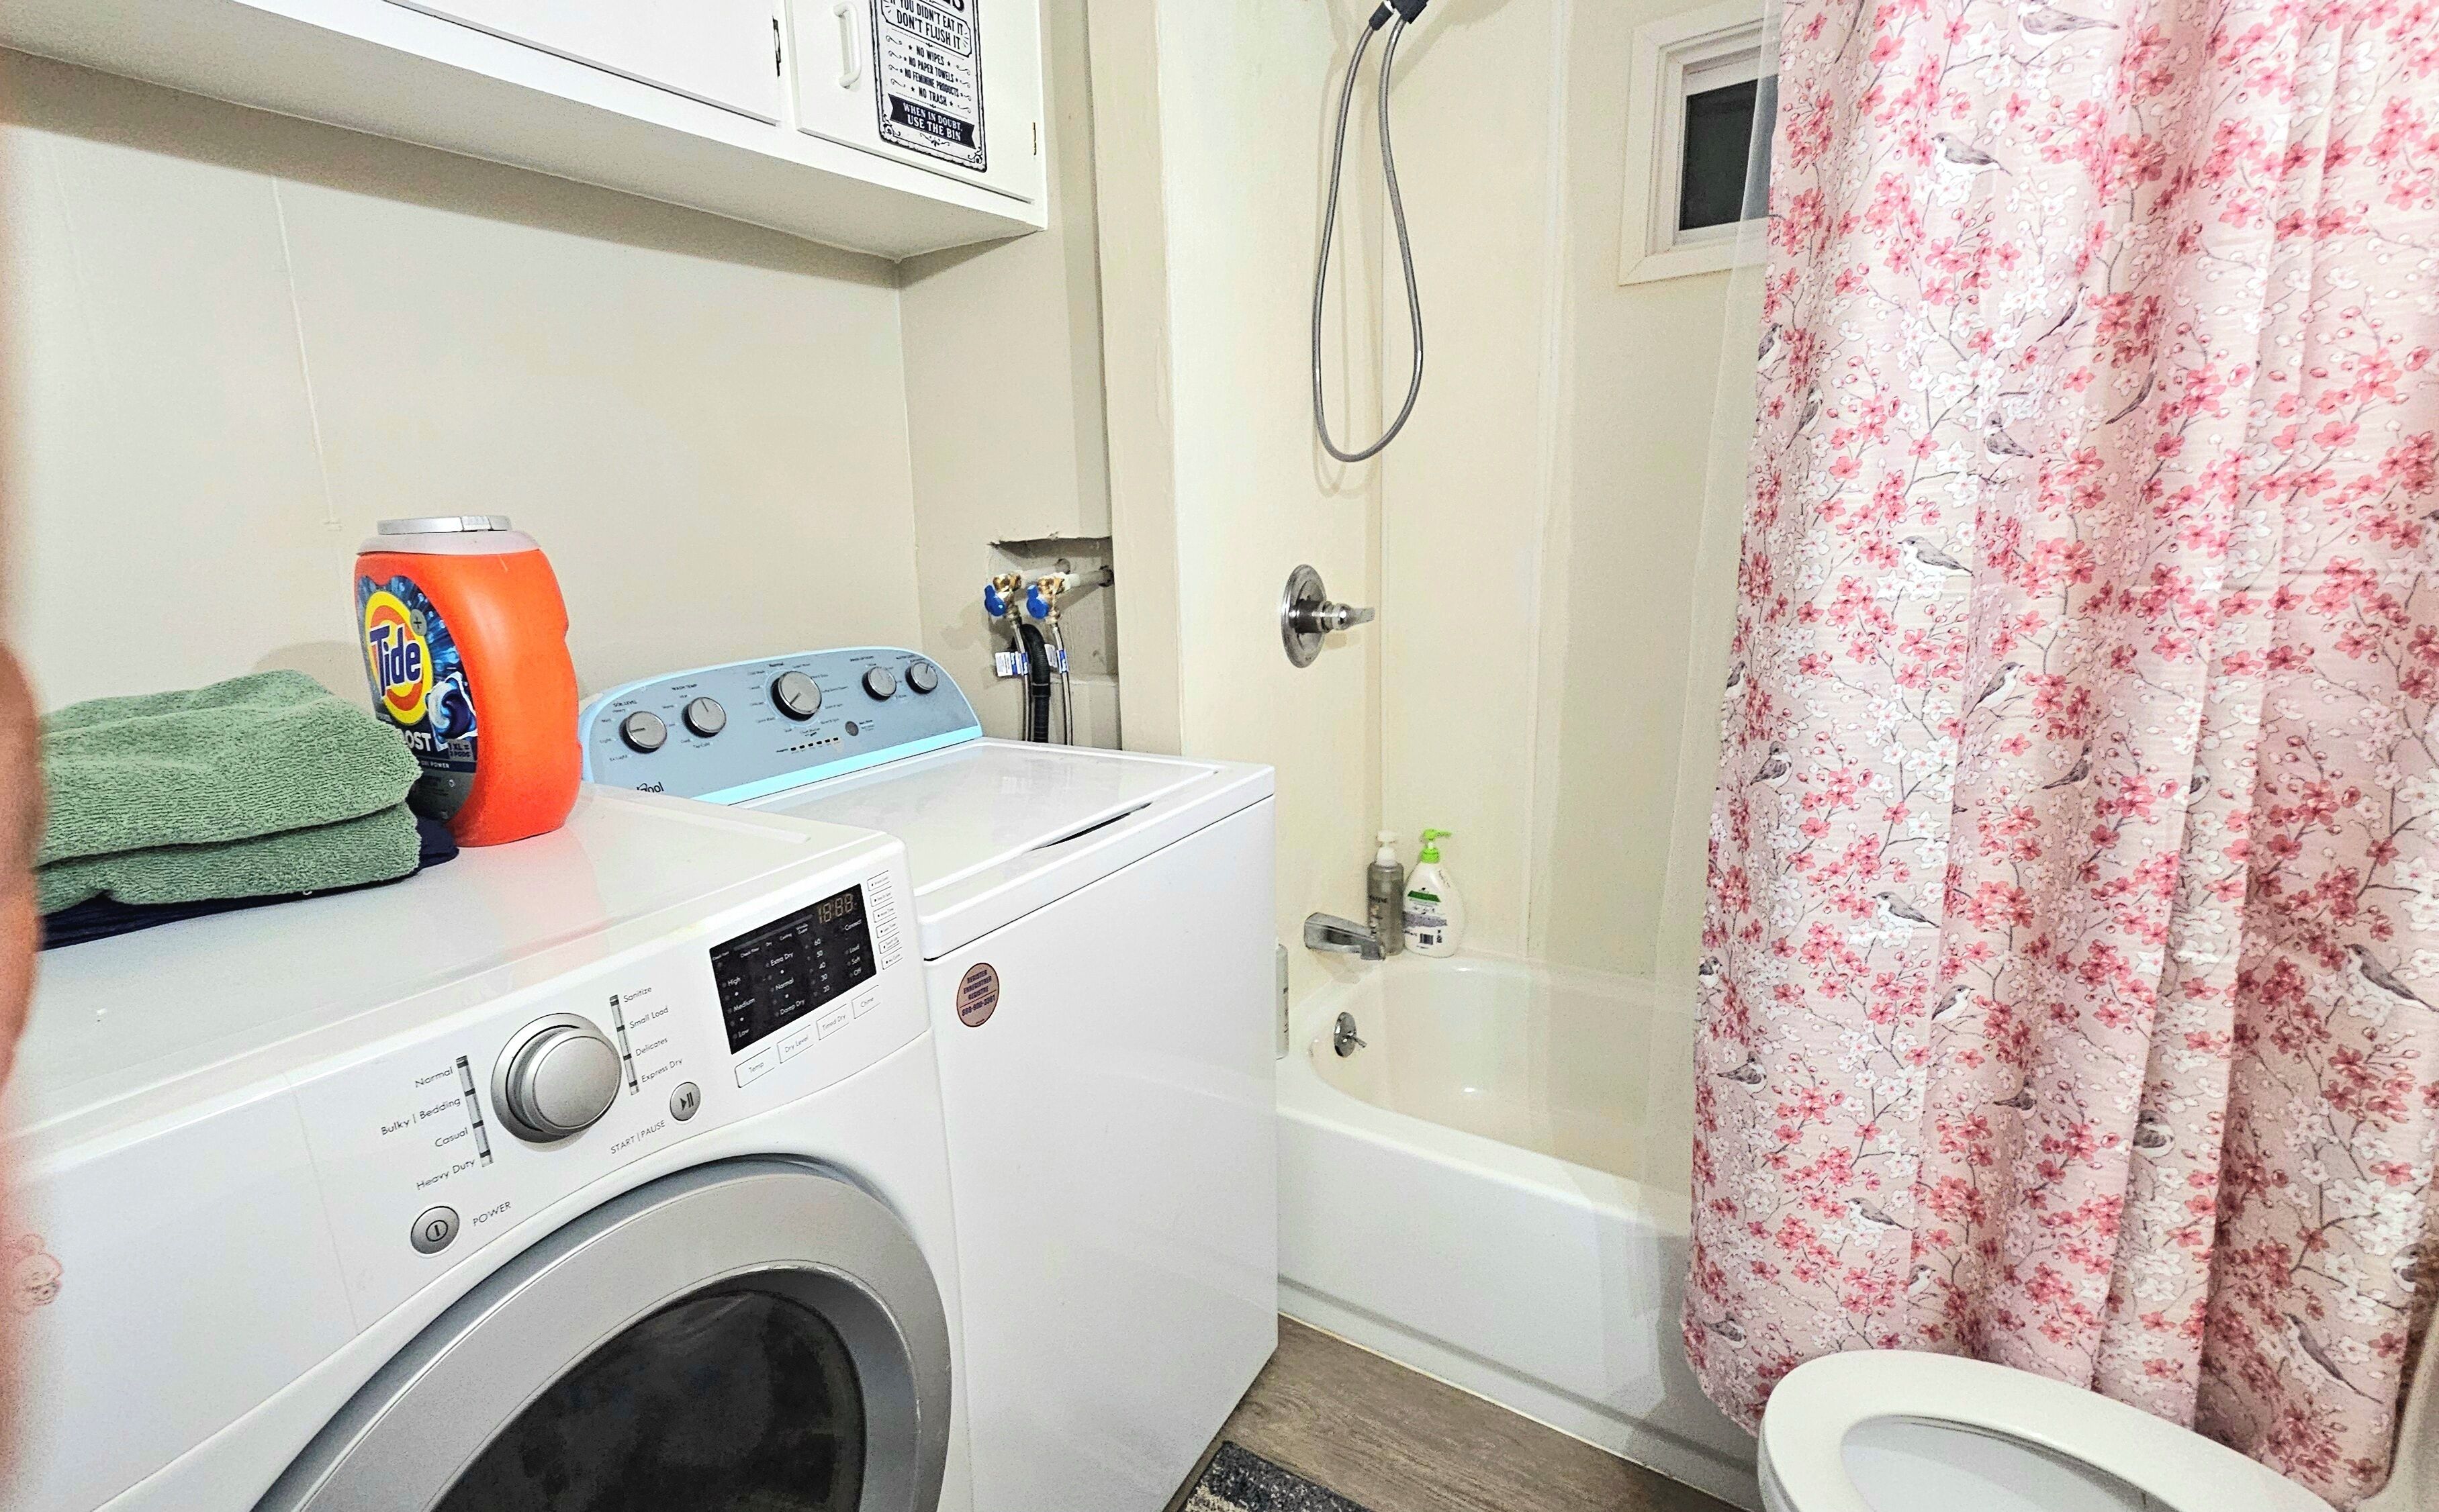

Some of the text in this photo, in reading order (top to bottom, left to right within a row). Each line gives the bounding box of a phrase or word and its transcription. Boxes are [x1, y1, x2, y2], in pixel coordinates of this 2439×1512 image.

[917, 3, 940, 24] DIDN'T
[944, 15, 955, 32] EAT
[957, 21, 963, 35] IT
[896, 9, 960, 50] DON'T FLUSH IT
[917, 46, 944, 66] NO WIPES
[905, 68, 911, 79] NO
[909, 56, 954, 83] NO PAPER TOWELS
[919, 87, 947, 106] NO TRASH
[903, 102, 926, 117] WHEN
[928, 111, 935, 122] IN
[907, 114, 961, 141] USE THE BIN
[370, 625, 421, 696] Tide
[405, 730, 431, 751] OST
[814, 938, 821, 946] 60
[849, 943, 860, 953] Loud
[770, 952, 794, 966] Extra Dry
[852, 956, 861, 965] Soft
[727, 976, 741, 986] High
[776, 977, 794, 990] Normal
[821, 974, 828, 982] 30
[623, 986, 652, 1002] Sanitize
[823, 985, 830, 993] 20
[733, 998, 755, 1012] Medium
[780, 999, 804, 1016] Damp Dry
[629, 1005, 669, 1029] Small Load
[822, 1014, 846, 1031] Timed Dry
[738, 1029, 749, 1038] Low
[635, 1037, 668, 1056] Delicates
[784, 1043, 794, 1053] Dry
[415, 1066, 453, 1088] Normal
[641, 1058, 683, 1083] Express Dry
[749, 1061, 764, 1074] Temp
[381, 1098, 461, 1135] Bulky Bedding
[435, 1127, 468, 1147] Casual
[610, 1119, 666, 1154] START PAUSE
[416, 1159, 475, 1190] Heavy Duty
[472, 1200, 512, 1227] POWER
